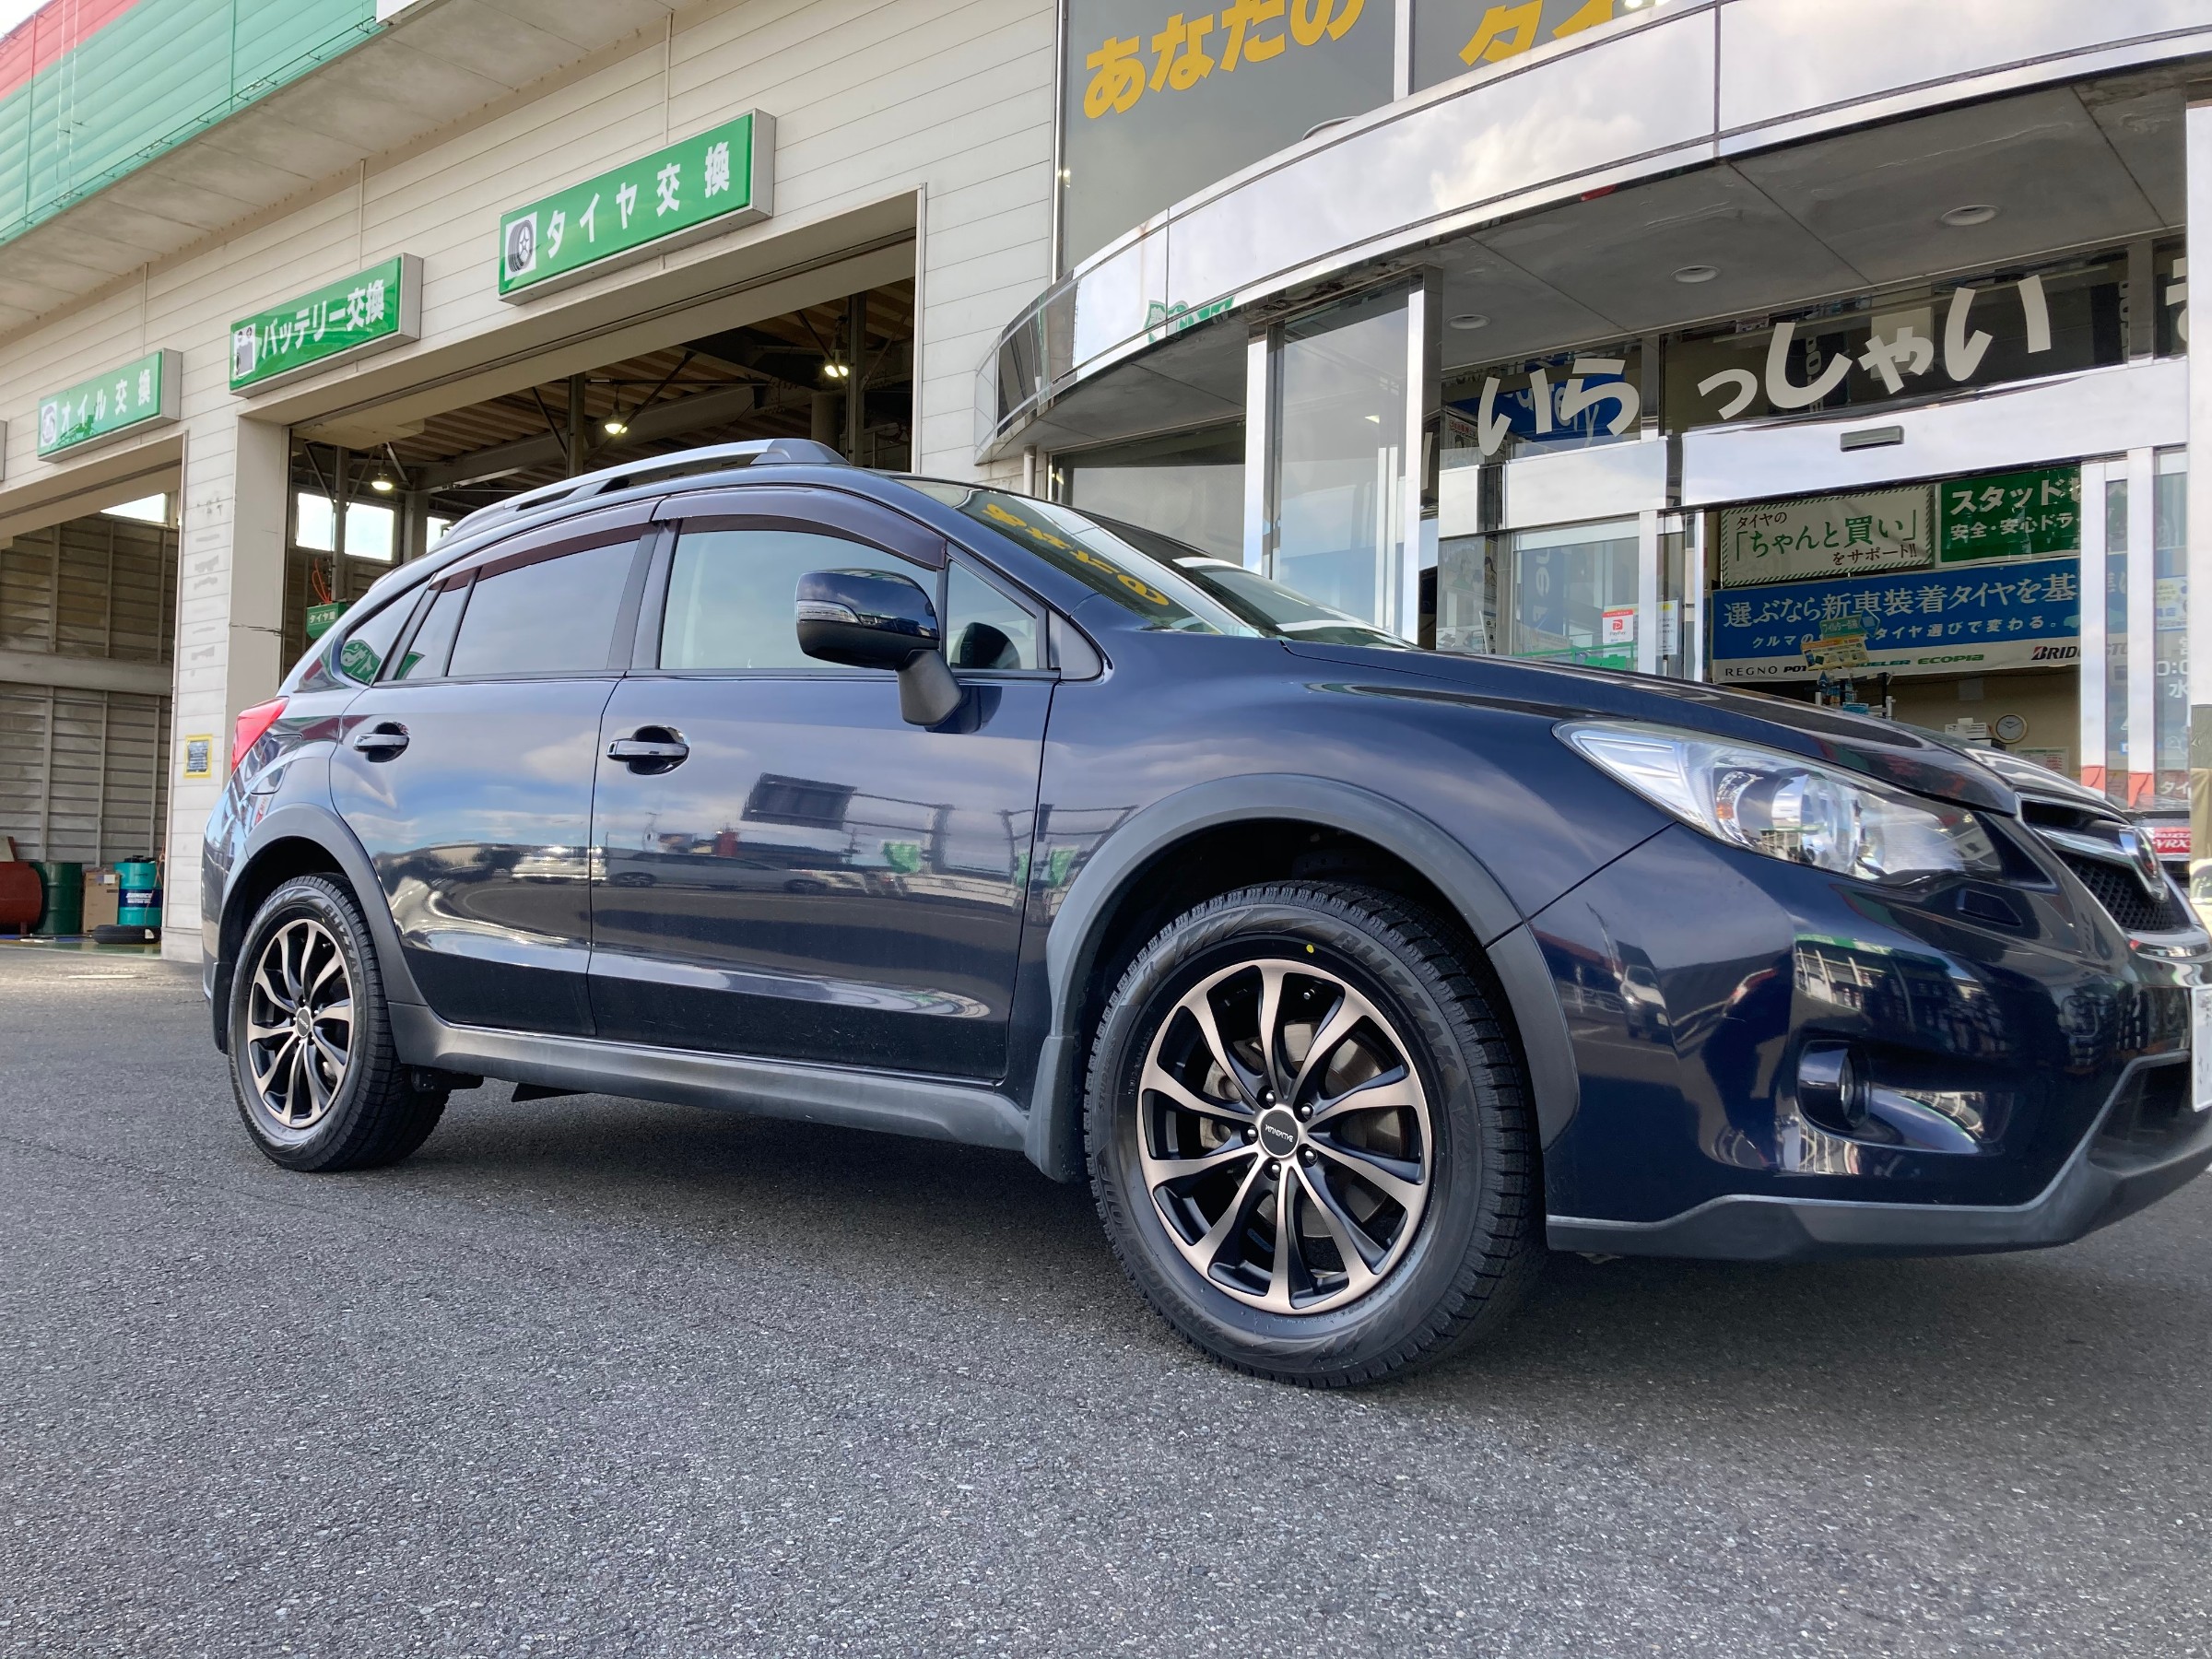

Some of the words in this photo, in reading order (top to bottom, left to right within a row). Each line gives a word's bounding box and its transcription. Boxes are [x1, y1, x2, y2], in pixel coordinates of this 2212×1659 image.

[1083, 0, 1365, 119] あなたの
[547, 141, 730, 259] タイヤ交換
[261, 278, 385, 360] バッテリー交換
[61, 369, 151, 433] オイル交換
[1736, 512, 1788, 531] タイヤの
[1949, 476, 2081, 516] スタッド
[1736, 509, 1916, 562] 「ちゃんと買い」
[1949, 511, 2081, 542] 安全・安心ドラ
[1723, 571, 2079, 629] 選ぶなら新車装着タイヤを基
[1724, 665, 1779, 677] REGNO
[1332, 929, 1460, 1073] BLIZZAK
